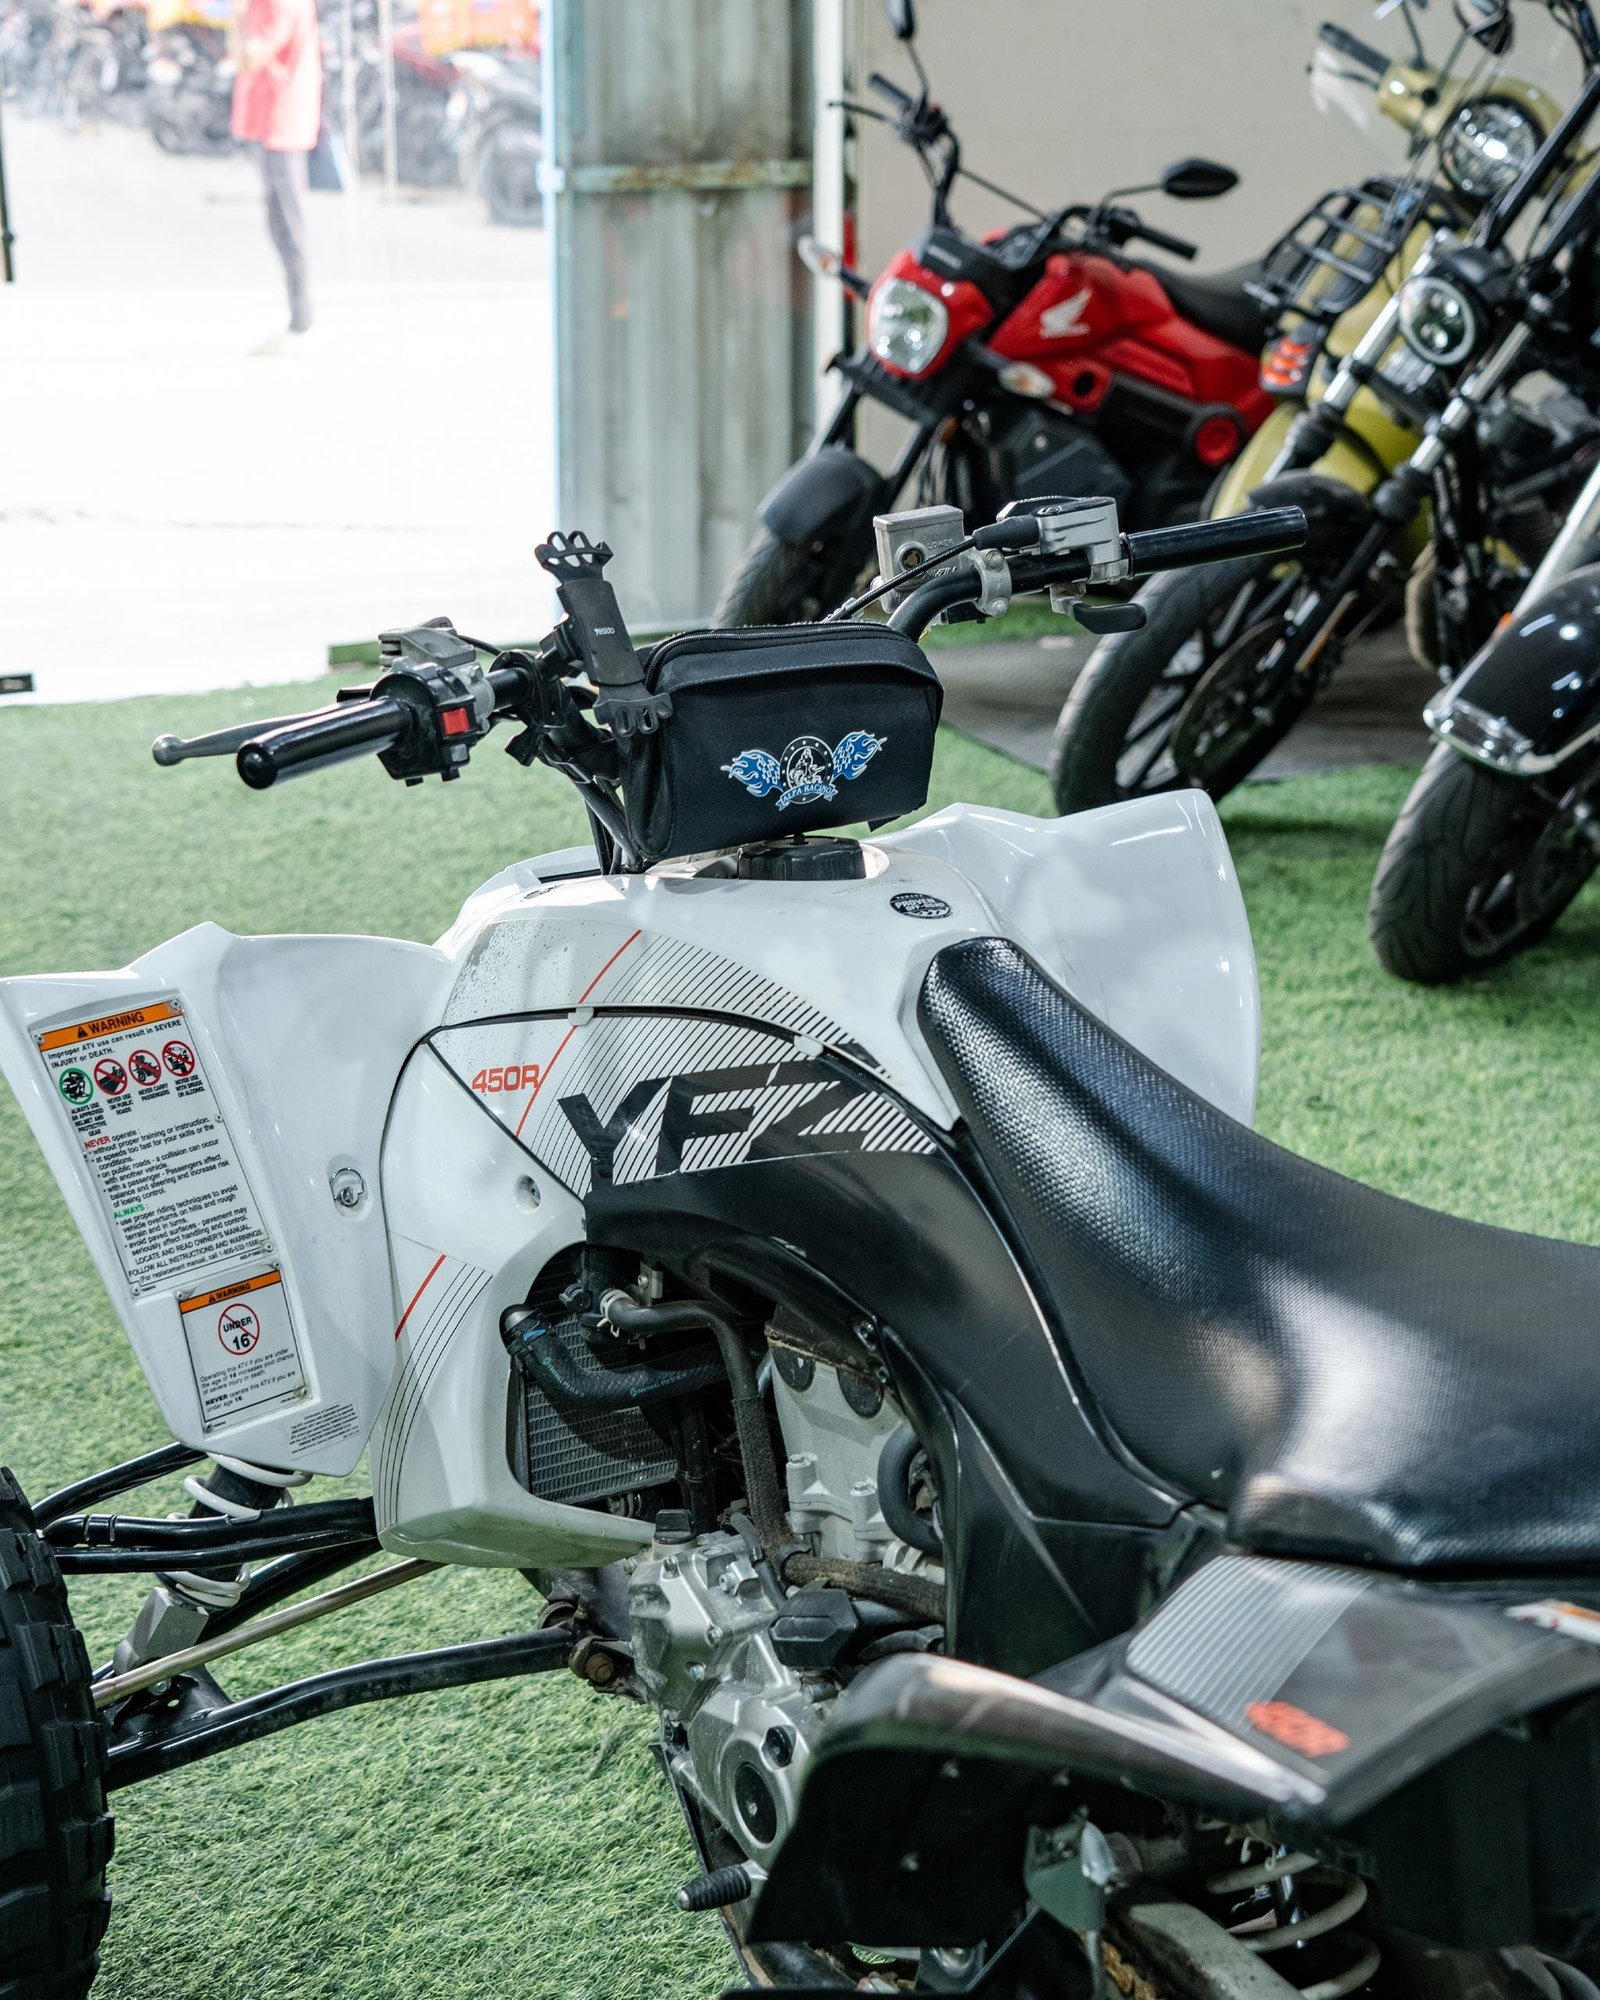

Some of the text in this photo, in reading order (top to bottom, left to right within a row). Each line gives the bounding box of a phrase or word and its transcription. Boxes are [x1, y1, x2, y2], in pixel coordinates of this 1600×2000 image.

[88, 1012, 144, 1032] WARNING
[48, 1047, 80, 1060] Improper
[82, 1042, 95, 1051] ATV
[125, 1029, 145, 1039] result
[154, 1019, 181, 1032] SEVERE
[51, 1057, 77, 1068] INJURY
[88, 1048, 114, 1059] DEATH.
[471, 1063, 541, 1093] 450R
[84, 1130, 137, 1149] NEVER operate
[92, 1143, 117, 1155] without
[118, 1137, 139, 1149] proper
[140, 1130, 166, 1141] training
[175, 1117, 210, 1131] instruction.
[103, 1149, 127, 1161] speeds
[127, 1146, 139, 1154] too
[139, 1141, 152, 1150] fast
[163, 1135, 177, 1145] your
[178, 1129, 196, 1139] skills
[99, 1157, 133, 1170] conditions.
[111, 1165, 131, 1177] public
[132, 1159, 151, 1169] roads
[161, 1148, 188, 1160] collision
[188, 1144, 201, 1152] can
[201, 1139, 219, 1149] occur
[105, 1163, 168, 1185] with another vehicle.
[107, 1184, 121, 1193] with
[127, 1173, 160, 1188] passenger
[165, 1160, 203, 1175] Passengers
[204, 1154, 221, 1164] affect
[110, 1160, 229, 1201] balance and steering and increase risk
[113, 1187, 166, 1208] of losing control.
[114, 1204, 145, 1219] ALWAYS
[120, 1218, 132, 1226] use
[133, 1211, 155, 1223] proper
[156, 1204, 176, 1214] riding
[176, 1193, 212, 1208] techniques
[220, 1184, 238, 1195] avoid
[123, 1222, 146, 1233] vehicle
[147, 1212, 179, 1226] overturns
[189, 1204, 203, 1212] hills
[204, 1199, 216, 1208] and
[217, 1193, 236, 1204] rough
[129, 1207, 247, 1249] avoid paved surfaces pavement may
[125, 1230, 147, 1241] terrain
[148, 1225, 161, 1234] and
[169, 1218, 188, 1227] turns.
[132, 1214, 248, 1256] seriously affect handling and control.
[135, 1224, 252, 1265] LOCATE AND READ OWNER'S MANUAL.
[128, 1264, 155, 1277] FOLLOW
[156, 1260, 169, 1268] ALL
[169, 1245, 214, 1264] INSTRUCTIONS
[215, 1240, 229, 1249] AND
[229, 1229, 263, 1244] WARNINGS.
[216, 1283, 251, 1298] WARNING
[223, 1316, 253, 1332] UNDER
[233, 1333, 250, 1350] 16
[205, 1394, 228, 1406] NEVER
